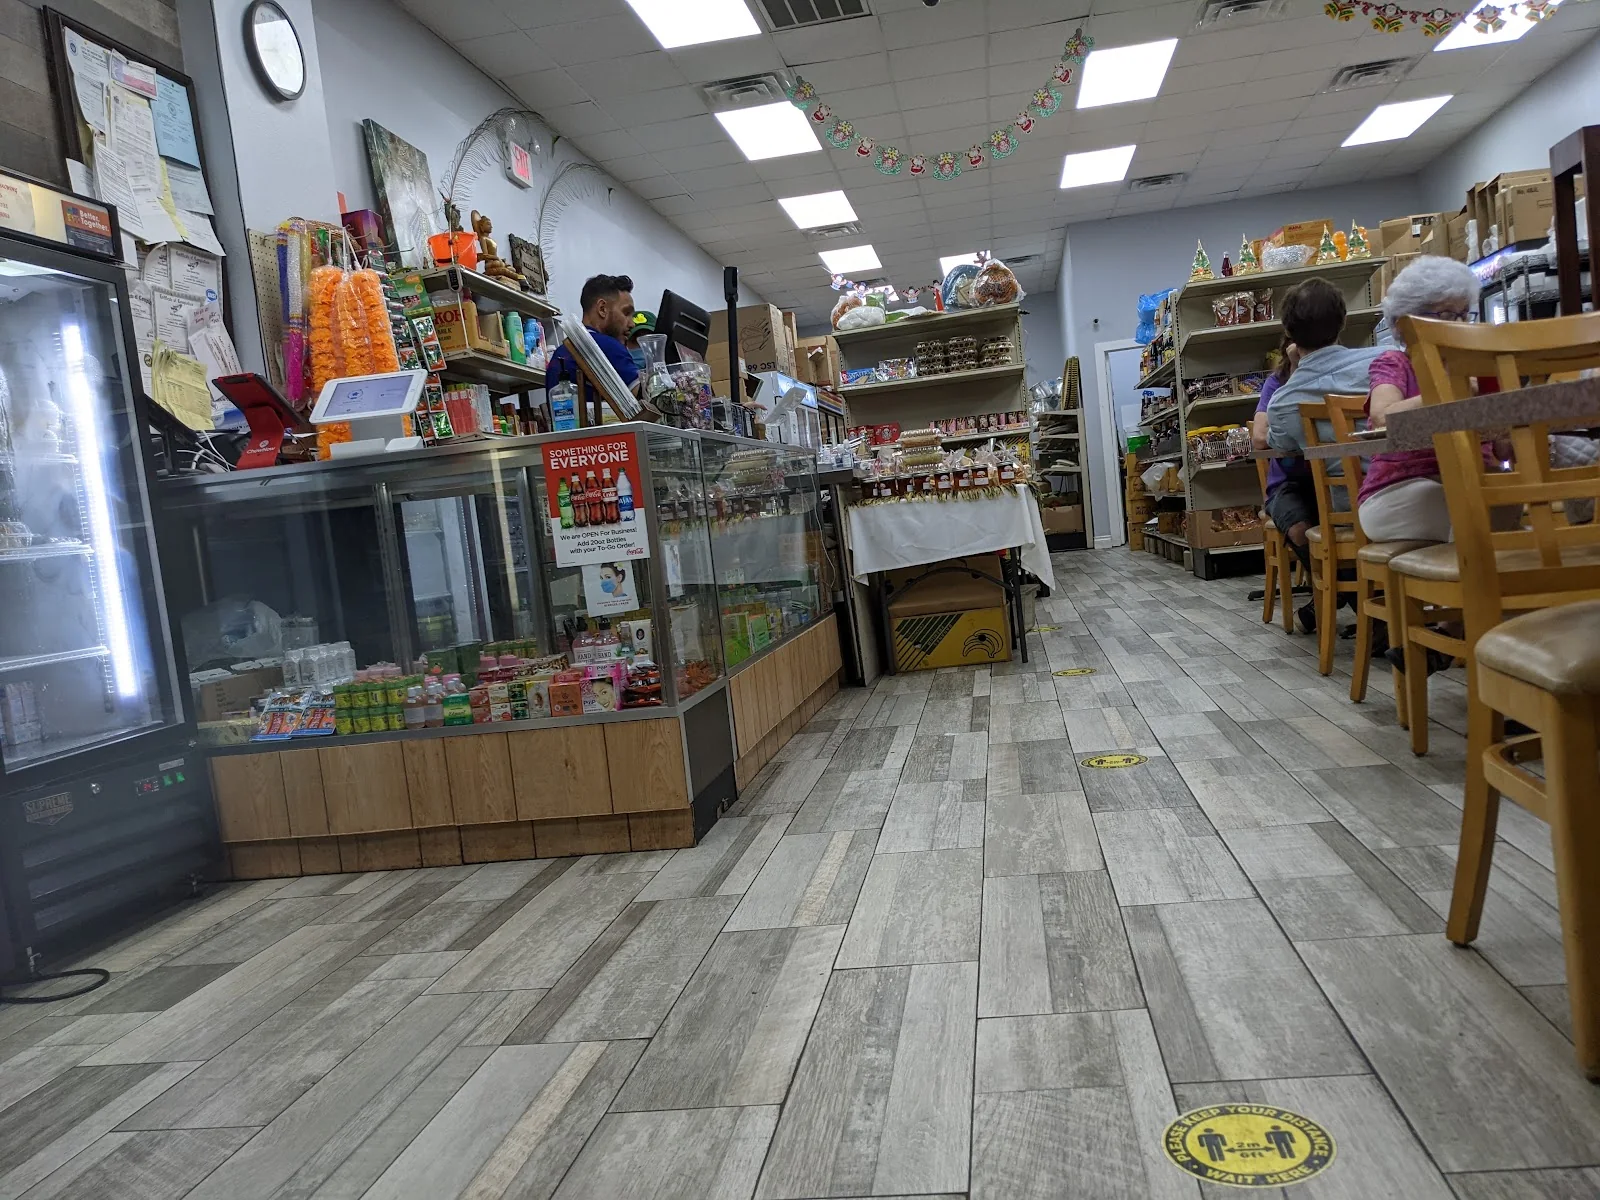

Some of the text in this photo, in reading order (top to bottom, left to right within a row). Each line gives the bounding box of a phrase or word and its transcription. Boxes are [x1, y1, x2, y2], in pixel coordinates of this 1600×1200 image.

[746, 363, 758, 372] 66
[549, 441, 627, 458] SOMETHING FOR
[550, 450, 629, 470] EVERYONE
[581, 531, 599, 539] OPEN
[611, 527, 637, 535] Business!
[583, 546, 597, 554] your
[598, 544, 616, 552] To-Go
[1166, 1106, 1329, 1162] PLEASE KEEP YOUR DISTANCE
[1236, 1141, 1261, 1149] 2m
[1239, 1151, 1265, 1159] 6ft
[1205, 1164, 1313, 1185] WAIT HERE
